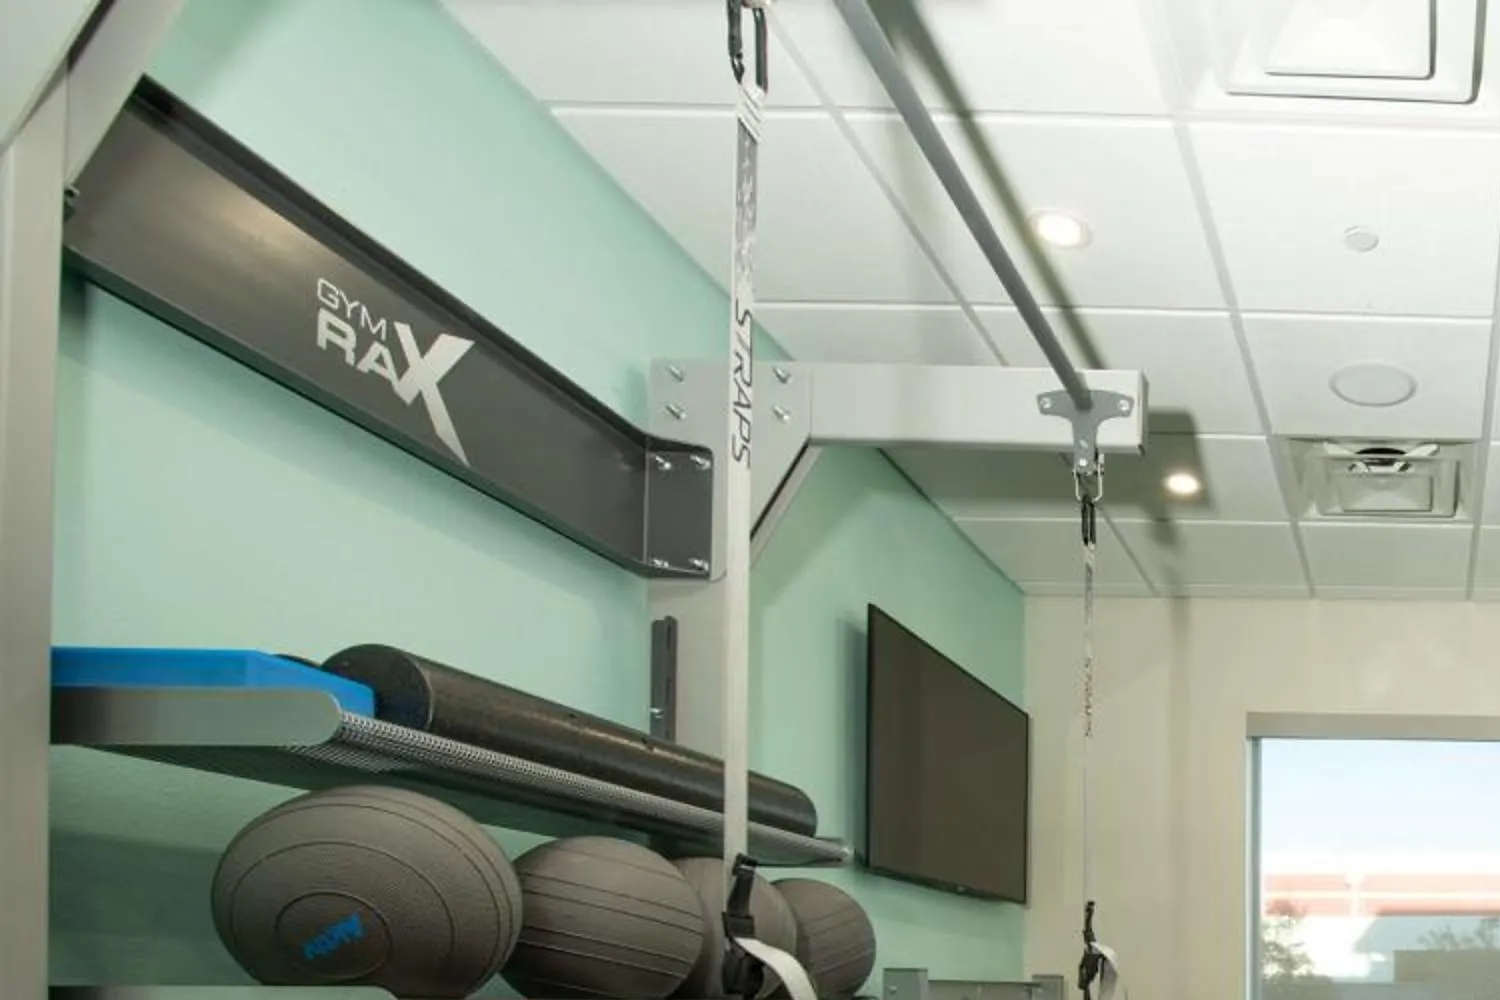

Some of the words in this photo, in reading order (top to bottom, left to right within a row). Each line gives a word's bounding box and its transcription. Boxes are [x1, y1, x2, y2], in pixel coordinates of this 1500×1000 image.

[316, 307, 476, 467] RAX
[317, 277, 387, 341] GYM
[731, 297, 753, 470] STRAPS
